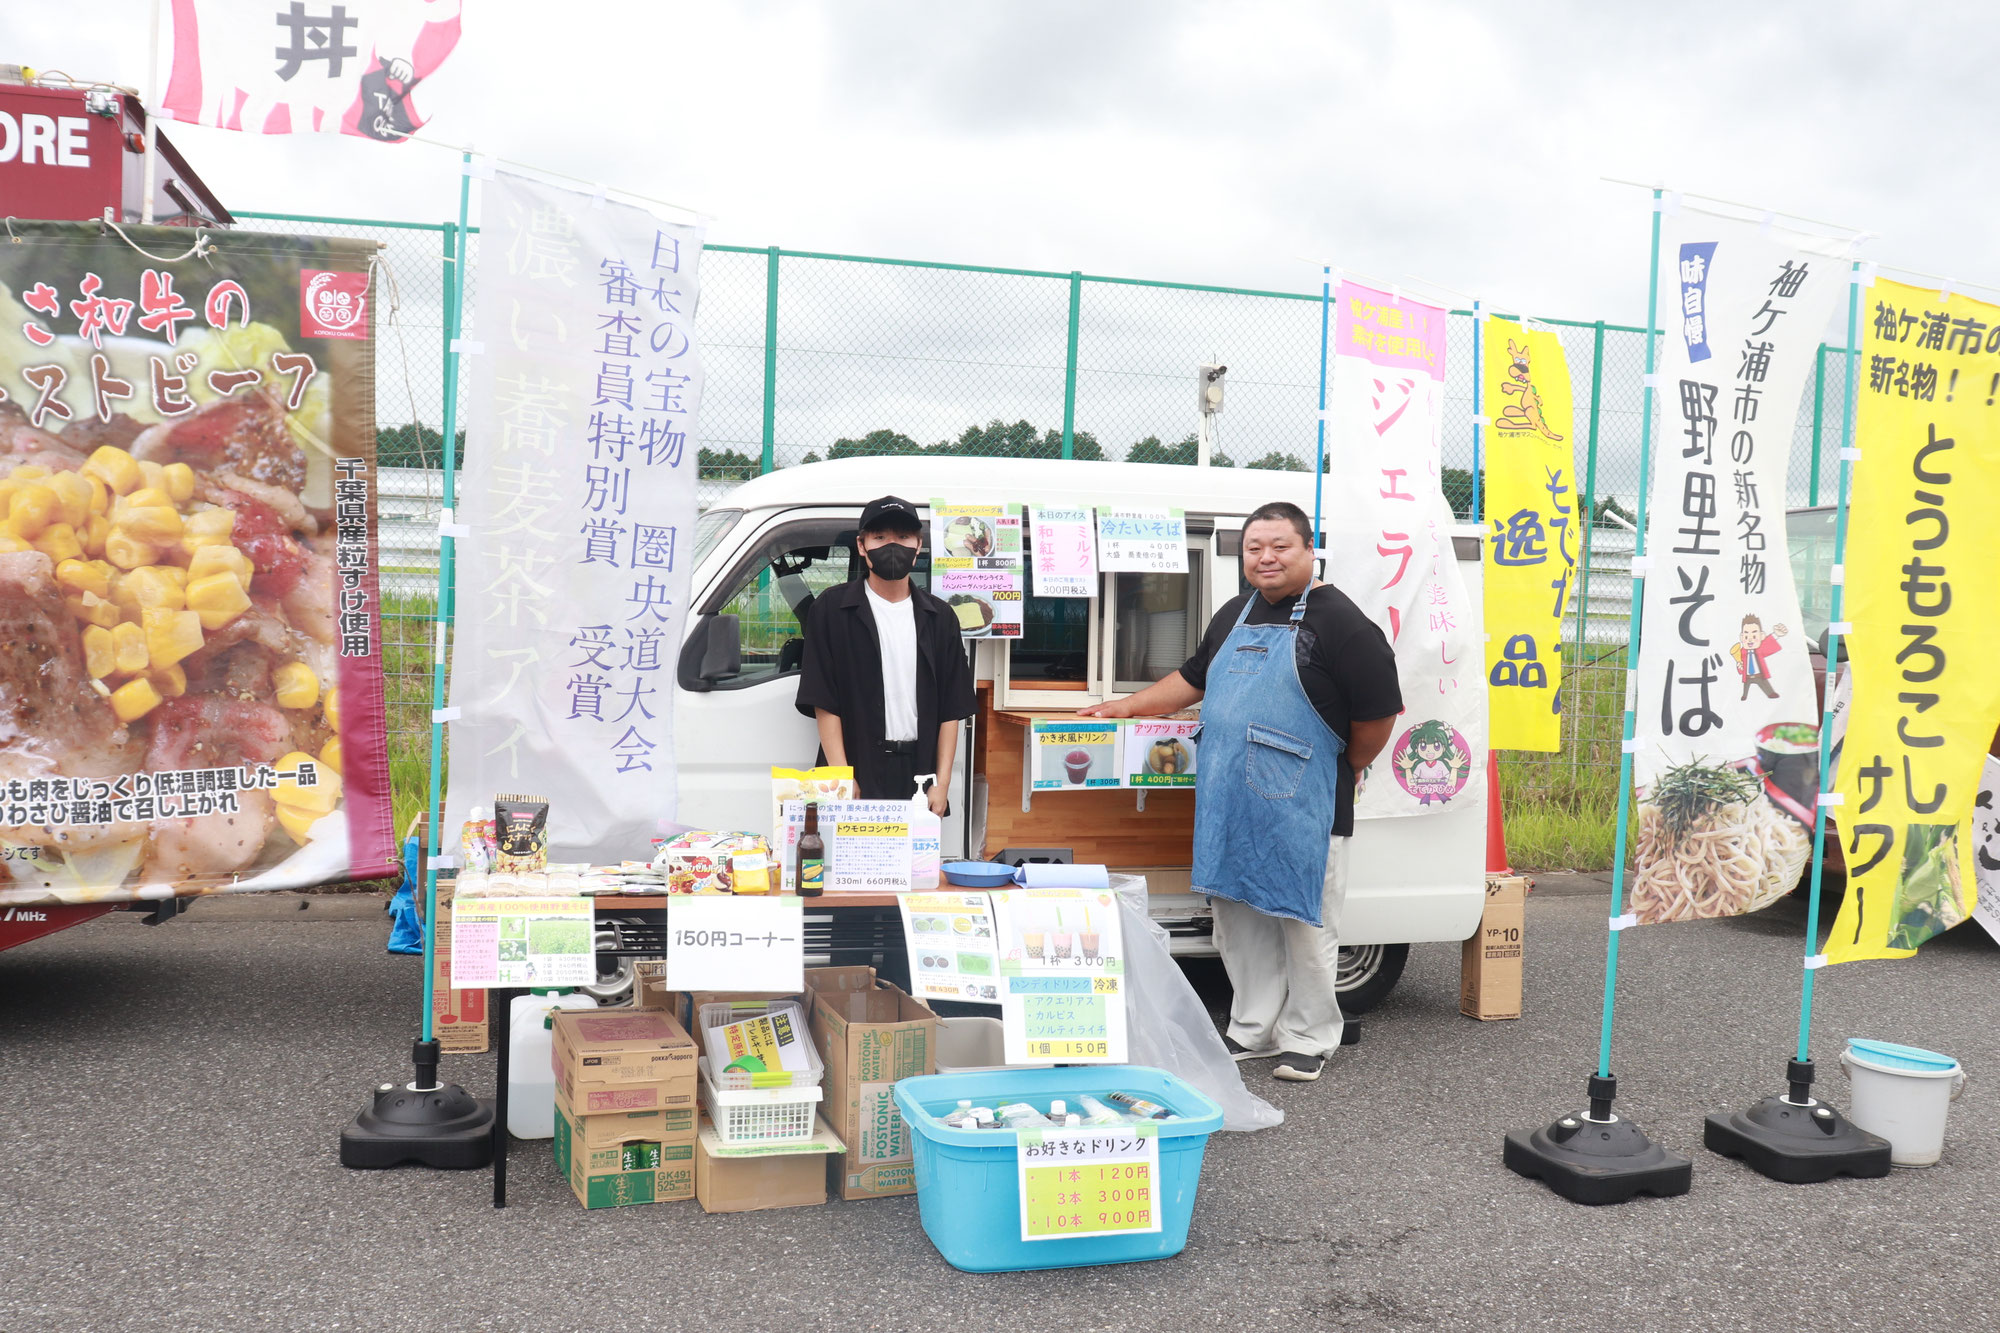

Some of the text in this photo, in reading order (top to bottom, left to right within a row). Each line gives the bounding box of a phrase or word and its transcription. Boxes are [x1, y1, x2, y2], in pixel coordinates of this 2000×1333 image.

[275, 1, 358, 82] 丼
[22, 268, 250, 350] さ和牛の
[0, 352, 316, 428] ストビーフ
[565, 257, 643, 722] 審査員特別賞 受賞
[1038, 510, 1086, 519] 本日のアイス
[1101, 519, 1182, 536] 冷たいそば
[1038, 524, 1056, 573] 和紅茶
[1076, 525, 1091, 569] ミルク
[1149, 543, 1178, 551] 400円
[1371, 378, 1416, 715] ジェラー
[335, 457, 371, 657] 千葉県産粒すけ使用
[995, 559, 1017, 567] 800円
[1151, 561, 1179, 569] 600円
[1661, 378, 1724, 738] 野里そば
[992, 591, 1021, 600] 700円
[1043, 585, 1088, 595] 300円税込
[1489, 508, 1549, 689] 逸品
[1895, 422, 1955, 815] とうもろこし
[609, 522, 677, 773] 圏央道大会
[1135, 723, 1171, 734] アツアツ
[1040, 732, 1108, 743] かき氷風ドリンク
[0, 763, 317, 802] も肉をじっくり低温調理した一品
[1100, 778, 1121, 786] 300円
[841, 814, 904, 823] リキュールを使った
[506, 823, 537, 833] にんにく
[836, 824, 908, 834] トウモロコシサワー
[507, 833, 533, 842] スナック
[0, 847, 41, 860] ジです
[1849, 755, 1894, 945] サワー
[835, 877, 908, 886] 330ml 660円税込
[674, 929, 796, 949] 150円コーナー
[1486, 928, 1519, 941] YP-10
[1041, 955, 1116, 967] 1杯 300円
[1010, 978, 1118, 992] ハンディドリンク 冷凍
[862, 1032, 872, 1081] POSTONIC
[1031, 1042, 1108, 1054] 1個 150円
[872, 1049, 881, 1080] WATER
[875, 1091, 889, 1159] POSTONIC
[889, 1115, 901, 1157] WATER
[1026, 1137, 1147, 1157] お好きなドリンク
[657, 1170, 691, 1180] GK491
[878, 1177, 908, 1187] WATER
[1058, 1166, 1149, 1183] 1本 120円
[615, 1176, 629, 1204] 生茶
[657, 1180, 675, 1192] 525
[1057, 1187, 1150, 1205] 3本 300円
[1098, 1209, 1150, 1224] 900円
